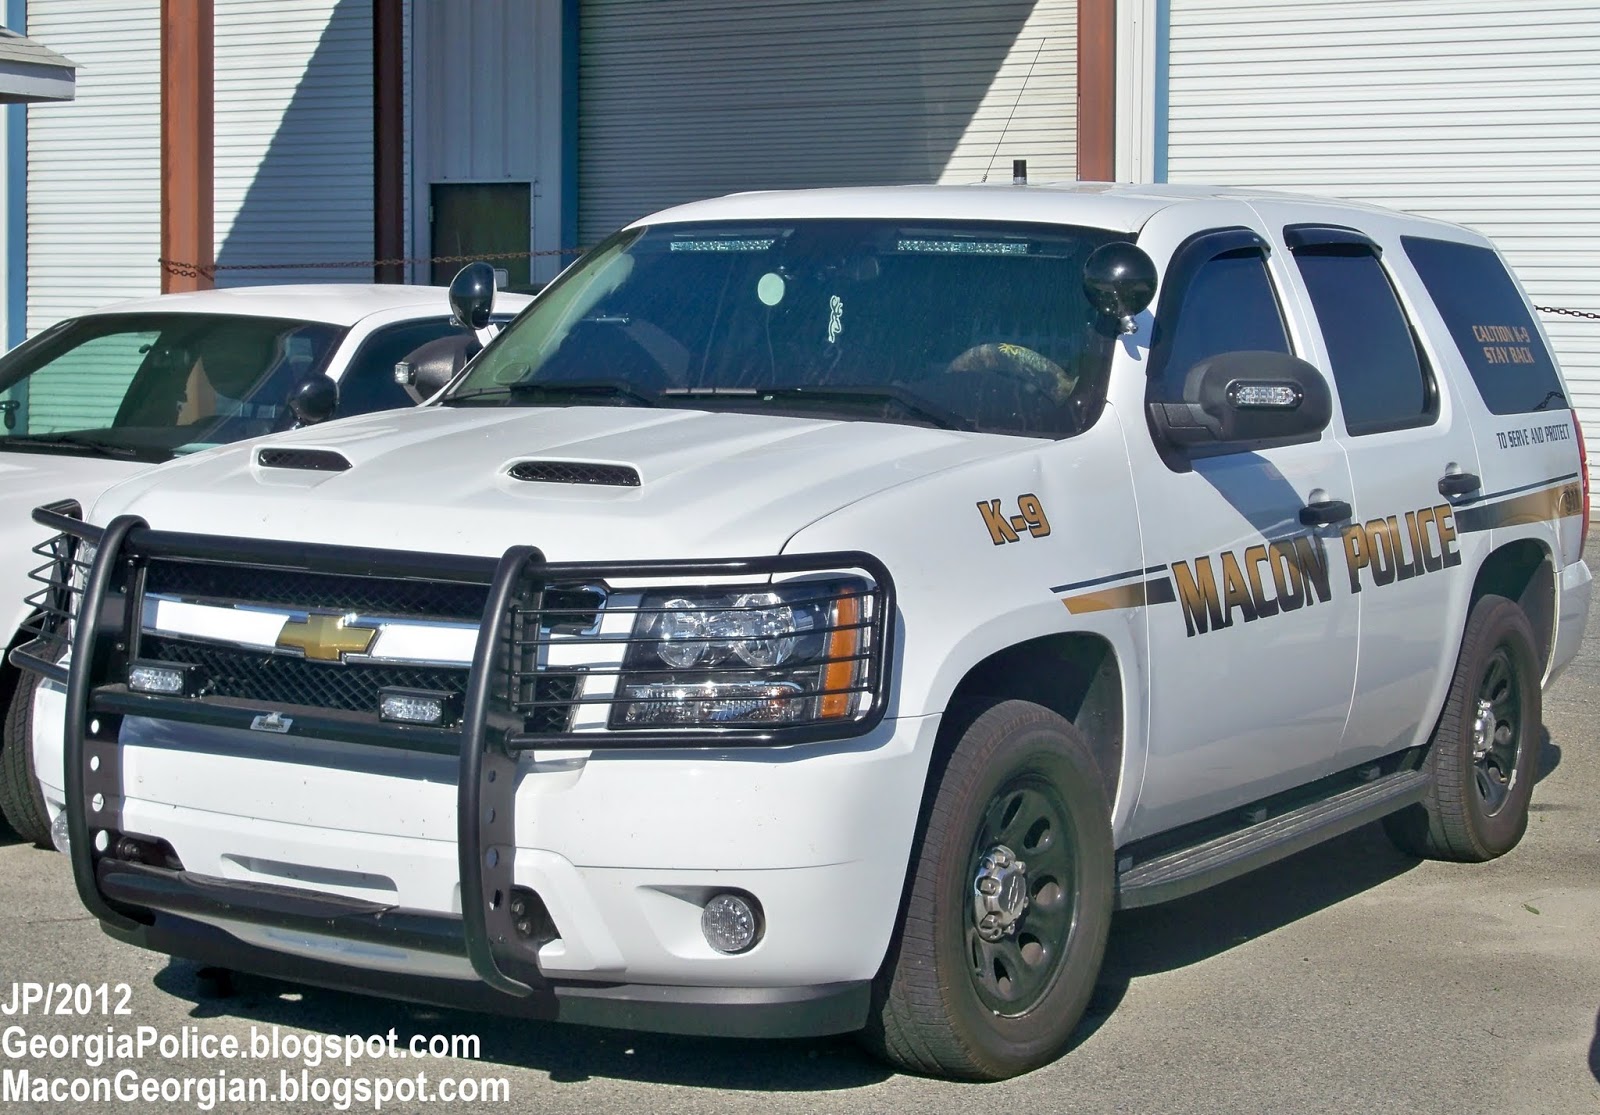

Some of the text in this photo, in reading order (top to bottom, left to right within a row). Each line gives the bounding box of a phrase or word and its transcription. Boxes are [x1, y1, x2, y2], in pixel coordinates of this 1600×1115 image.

[1472, 325, 1531, 343] CAUTION K-9
[1483, 346, 1535, 363] STAY BACK
[1496, 423, 1570, 449] TO SERVE AND PROTECT
[977, 493, 1051, 545] K-9
[1171, 503, 1462, 637] MACON POLICE
